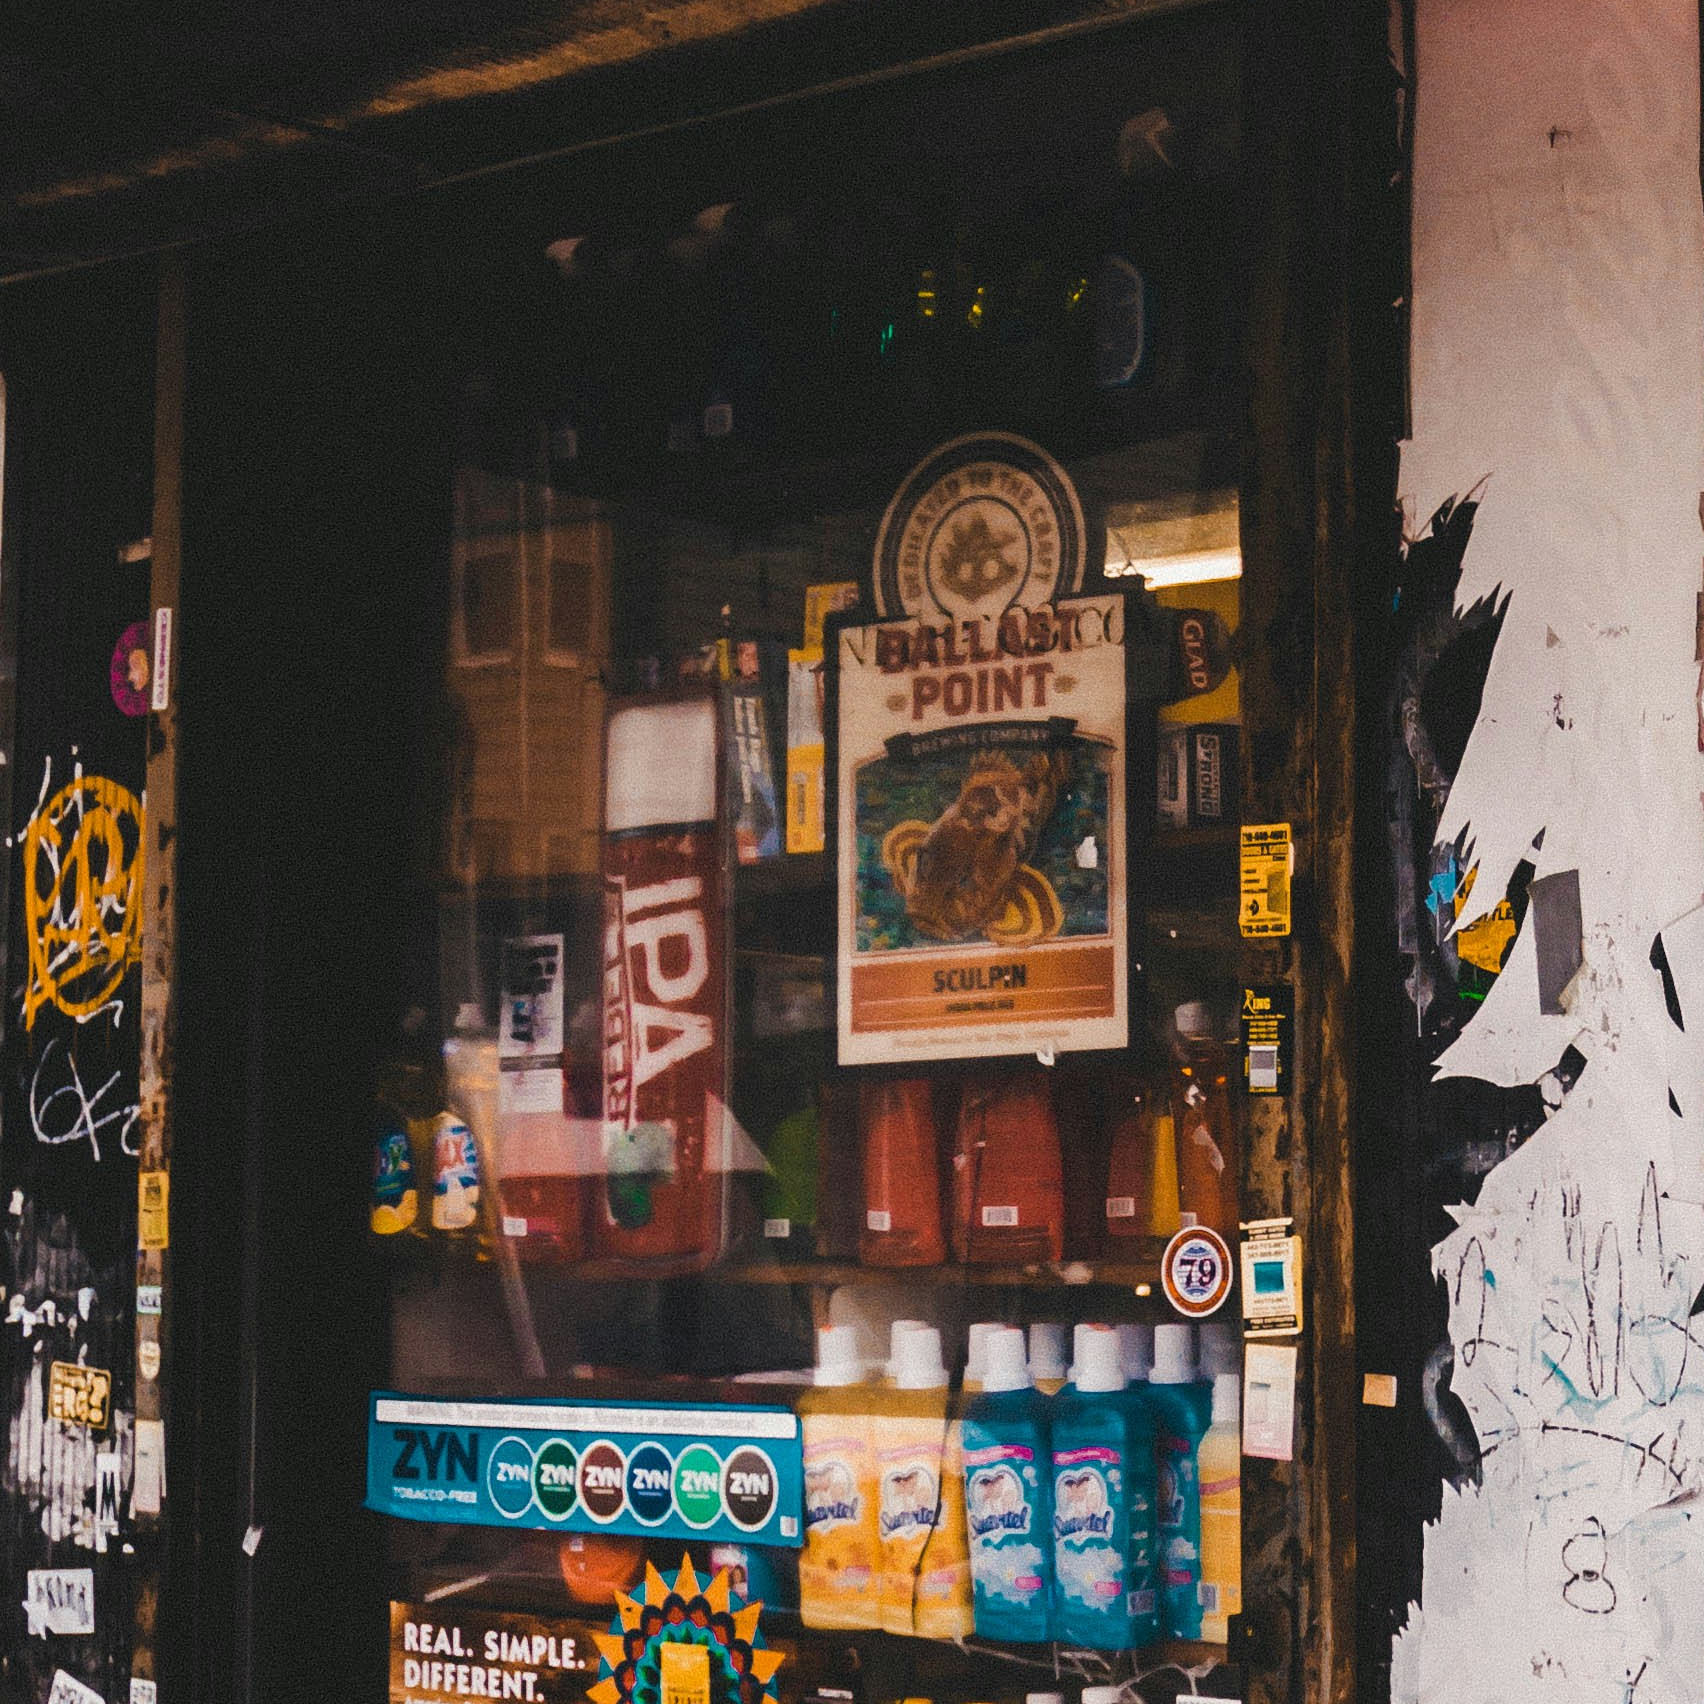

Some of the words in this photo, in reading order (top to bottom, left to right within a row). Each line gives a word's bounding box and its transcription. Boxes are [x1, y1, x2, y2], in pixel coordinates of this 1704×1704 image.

[1181, 618, 1209, 690] GLAD
[911, 662, 1054, 721] POINT
[623, 875, 713, 1087] IPA
[1178, 1258, 1217, 1288] 79
[391, 1430, 479, 1483] ZYN
[496, 1462, 530, 1484] ZYN
[540, 1463, 575, 1486] ZYN
[584, 1465, 623, 1489] ZYN
[632, 1467, 670, 1491] ZYN
[680, 1469, 721, 1495] ZYN
[729, 1472, 770, 1497] ZYN
[403, 1622, 474, 1657] REAL.
[484, 1629, 586, 1671] SIMPLE.
[403, 1657, 545, 1704] DIFFERENT.
